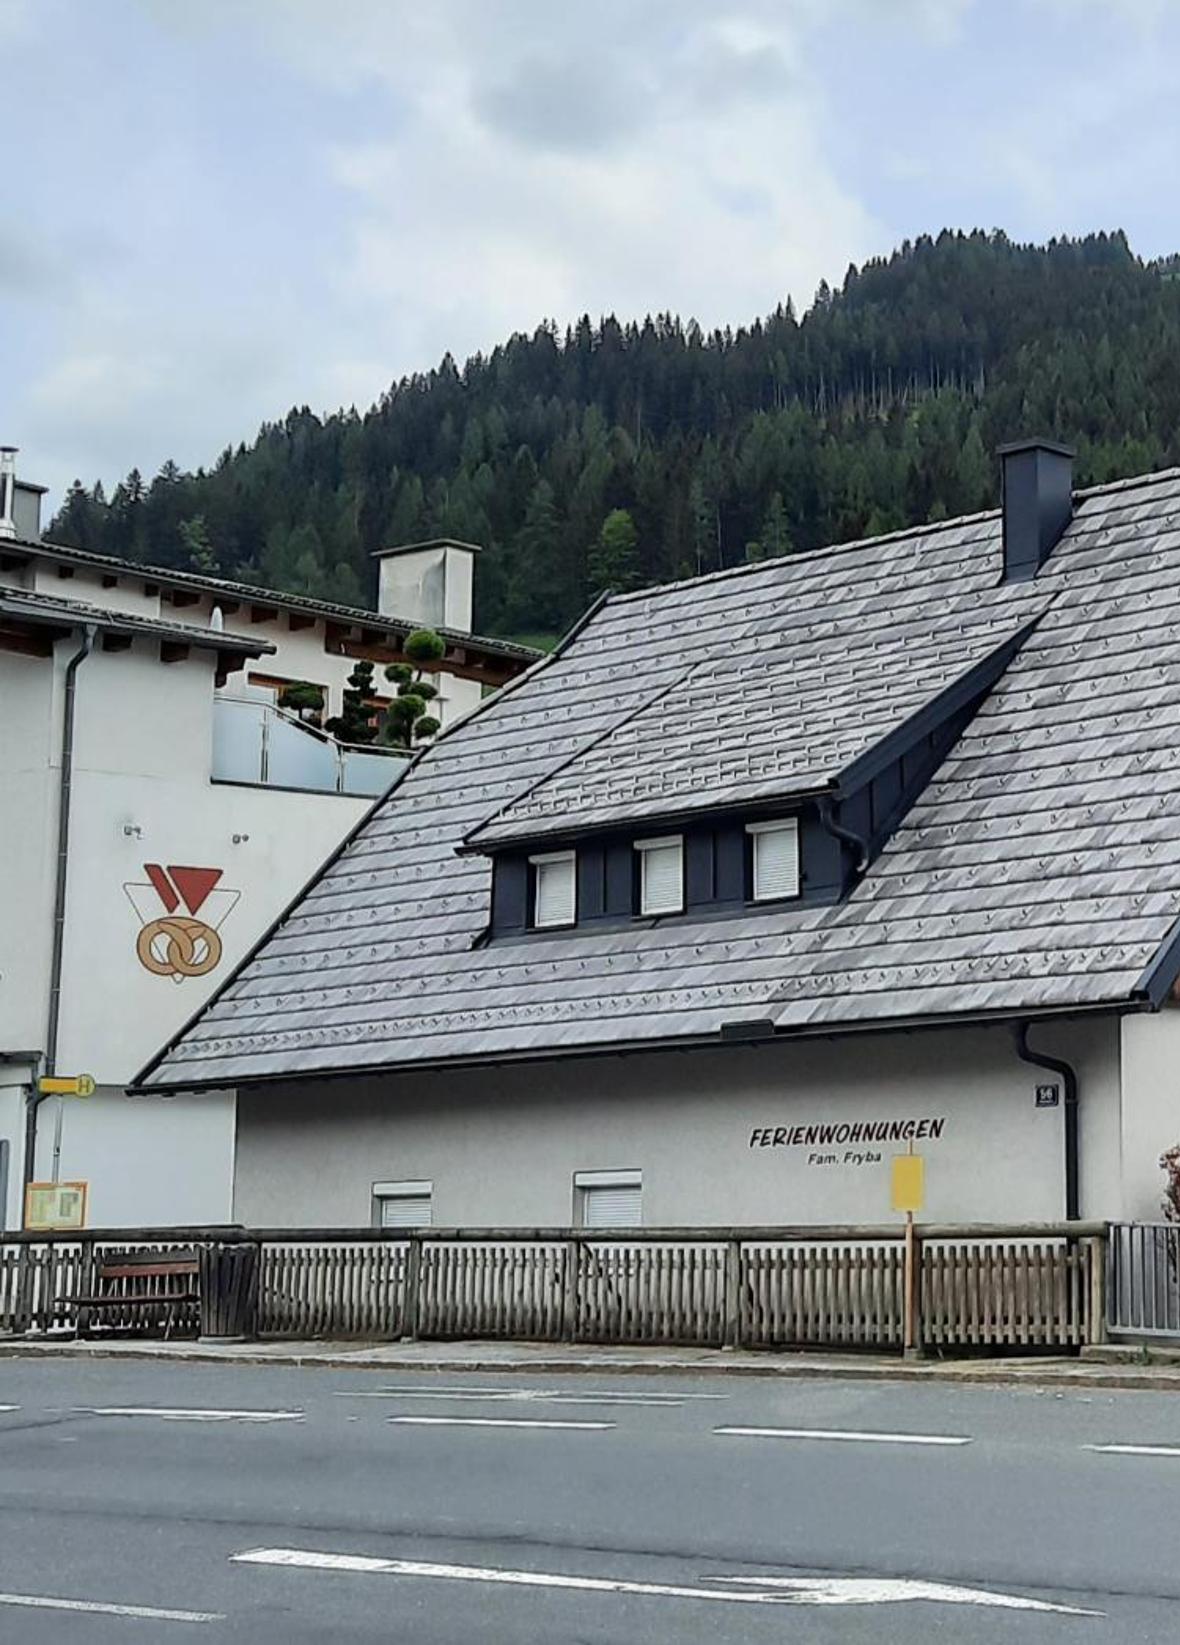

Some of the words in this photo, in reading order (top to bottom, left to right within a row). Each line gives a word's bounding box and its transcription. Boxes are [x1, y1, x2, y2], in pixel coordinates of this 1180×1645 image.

[750, 1118, 945, 1147] FERIENWOHNUNGEN
[808, 1153, 839, 1165] Fam.
[844, 1152, 882, 1165] Fryba
